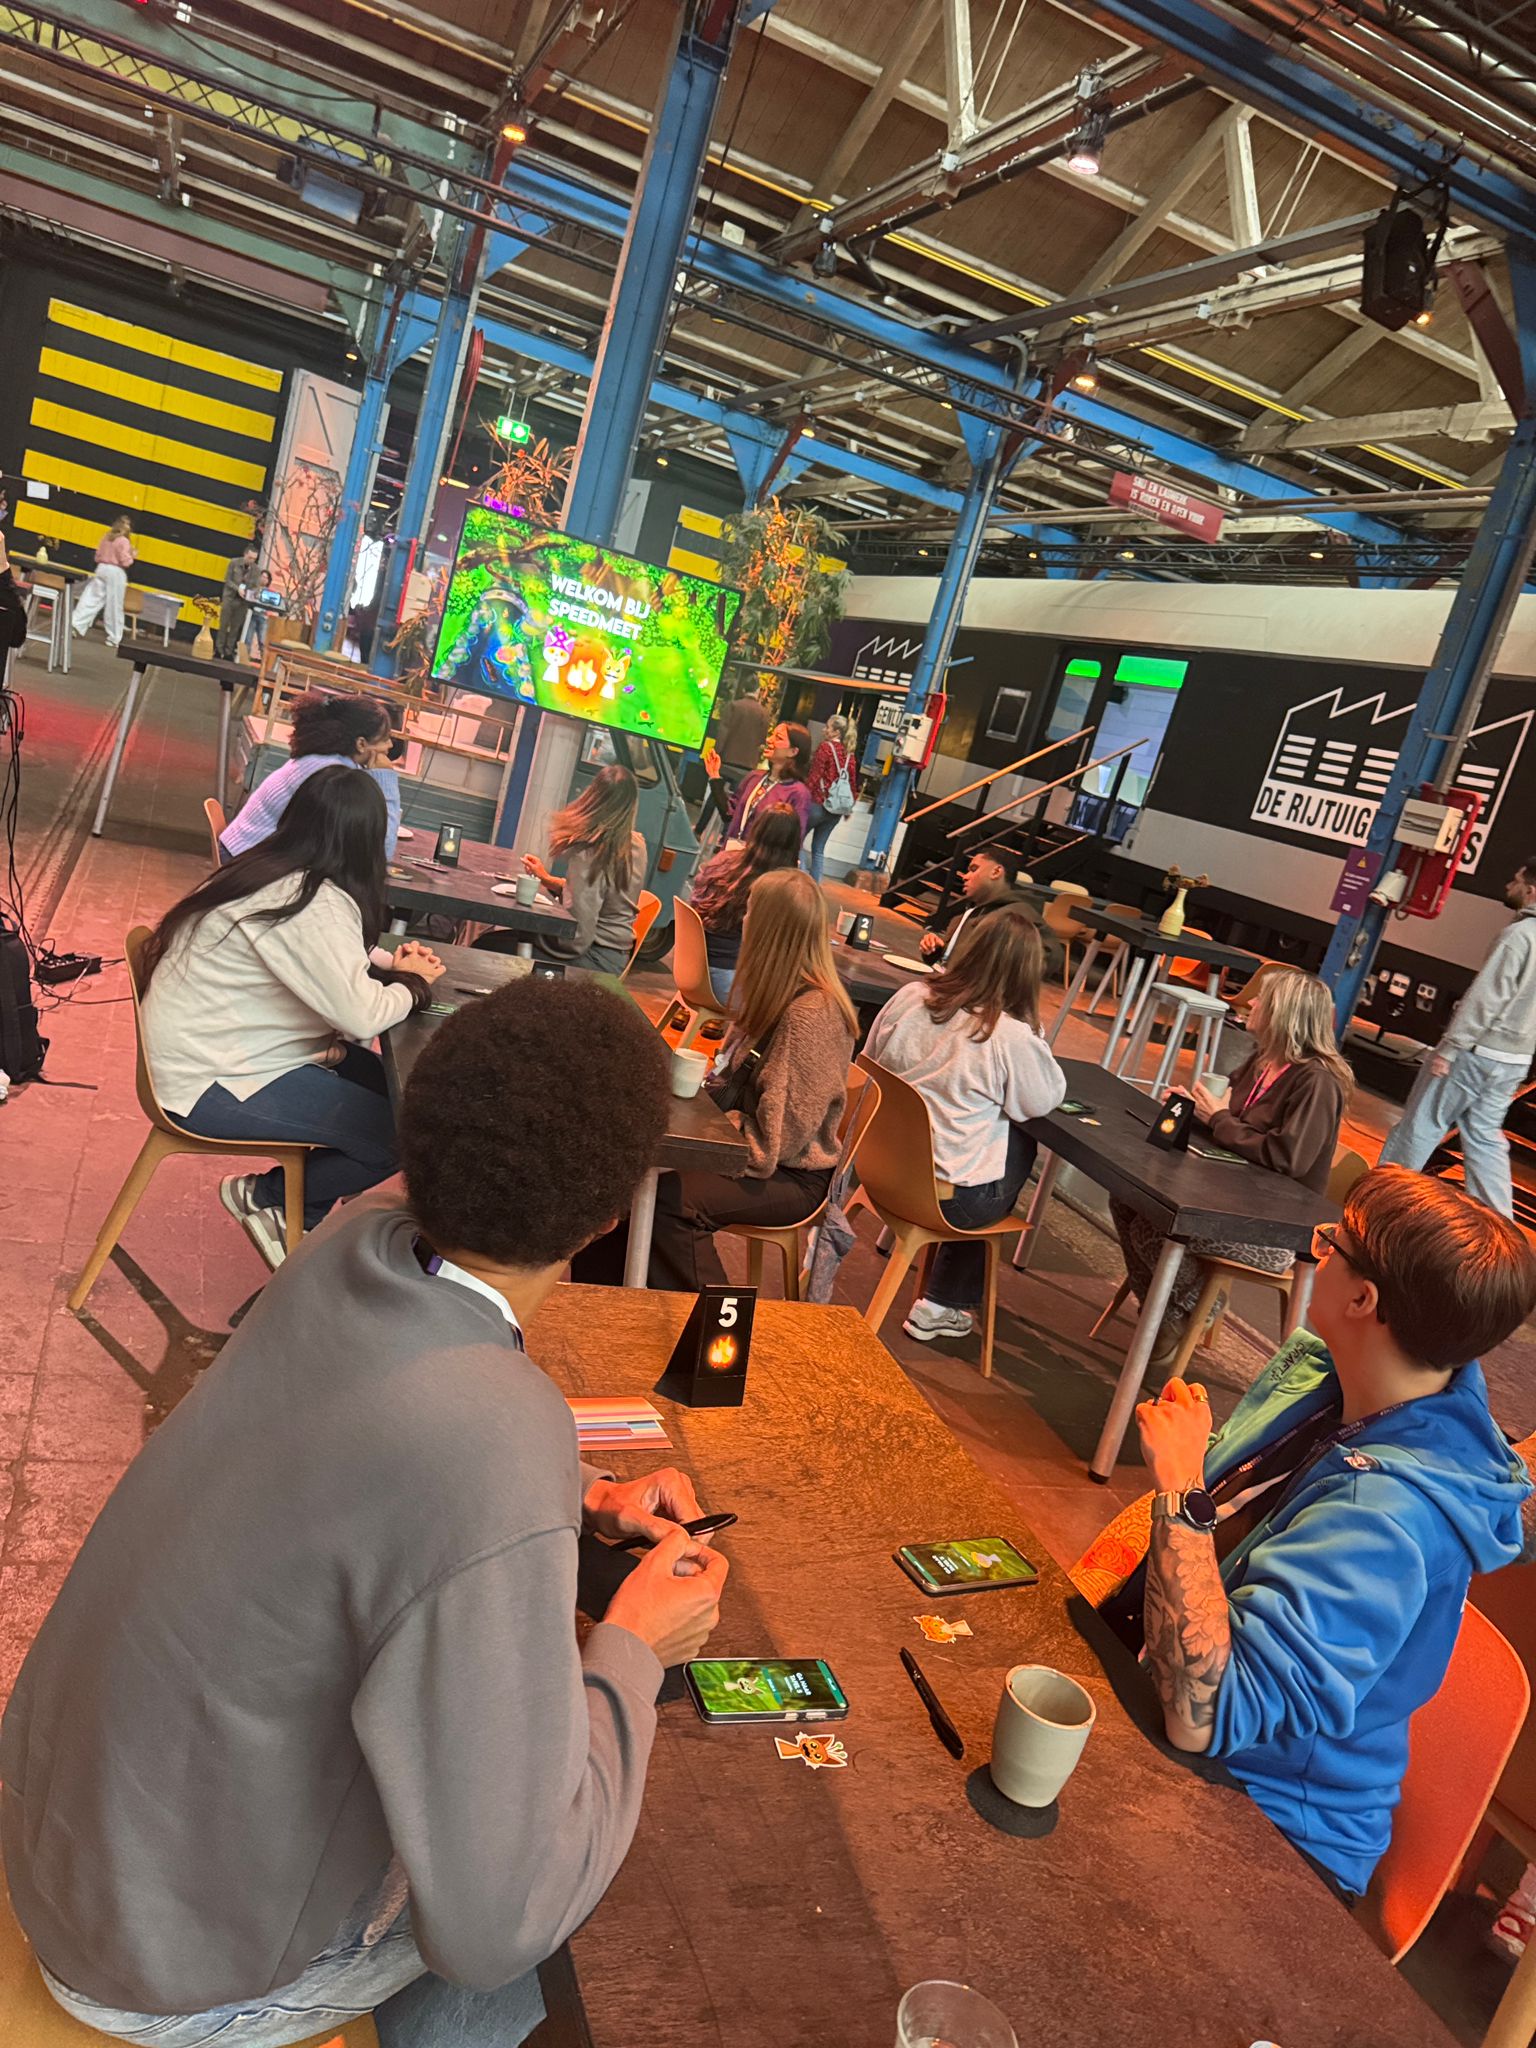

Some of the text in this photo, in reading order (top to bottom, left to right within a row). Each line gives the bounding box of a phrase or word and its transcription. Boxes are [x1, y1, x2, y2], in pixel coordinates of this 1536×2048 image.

[551, 573, 651, 619] WELKOM BIJ
[548, 598, 643, 640] SPEEDMEET
[1256, 787, 1286, 818] DE
[449, 827, 455, 839] 1
[860, 917, 870, 929] 2
[1170, 1102, 1182, 1117] 4
[718, 1297, 738, 1328] 5
